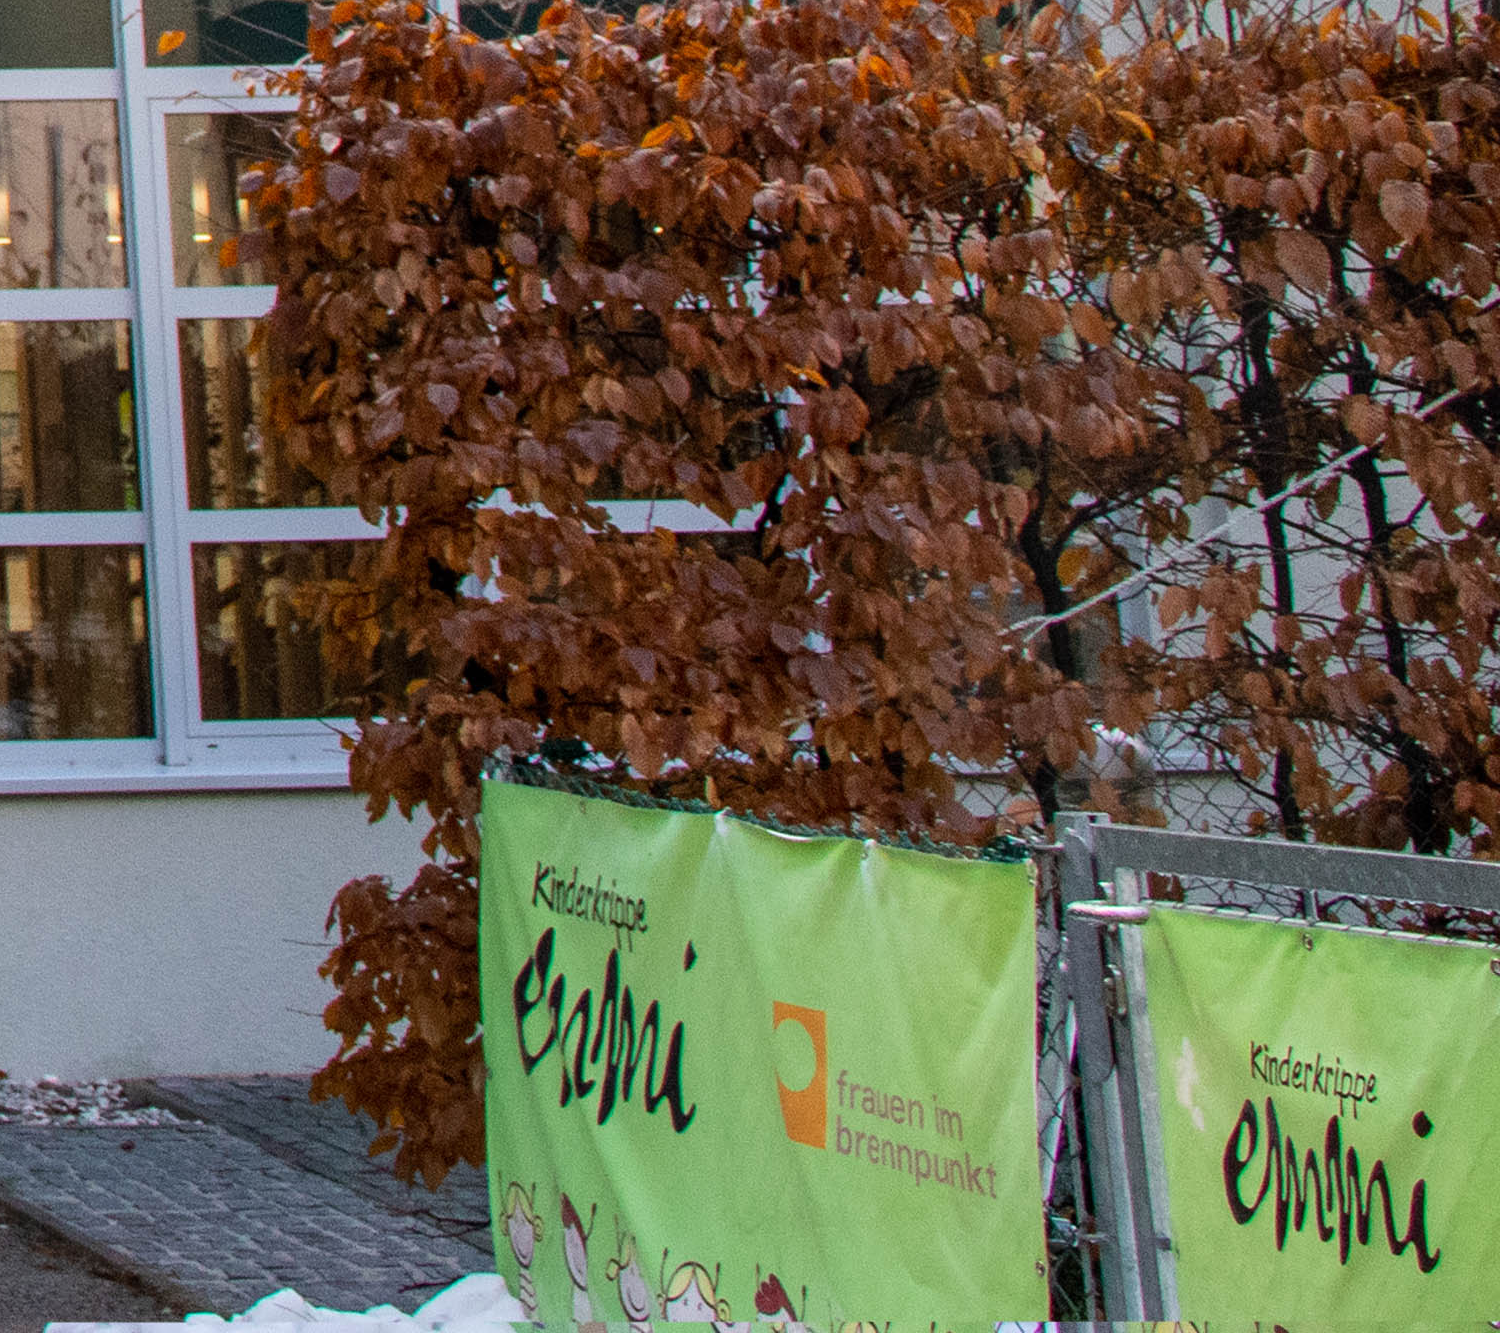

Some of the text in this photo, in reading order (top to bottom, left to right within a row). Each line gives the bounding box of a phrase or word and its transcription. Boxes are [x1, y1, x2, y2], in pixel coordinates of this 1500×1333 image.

[532, 860, 648, 953] Kinderkrippe
[836, 1069, 964, 1142] frauen im
[1250, 1040, 1378, 1120] Kinderkrippe
[835, 1114, 997, 1200] brennpunkt
[1222, 1095, 1441, 1274] emmi
